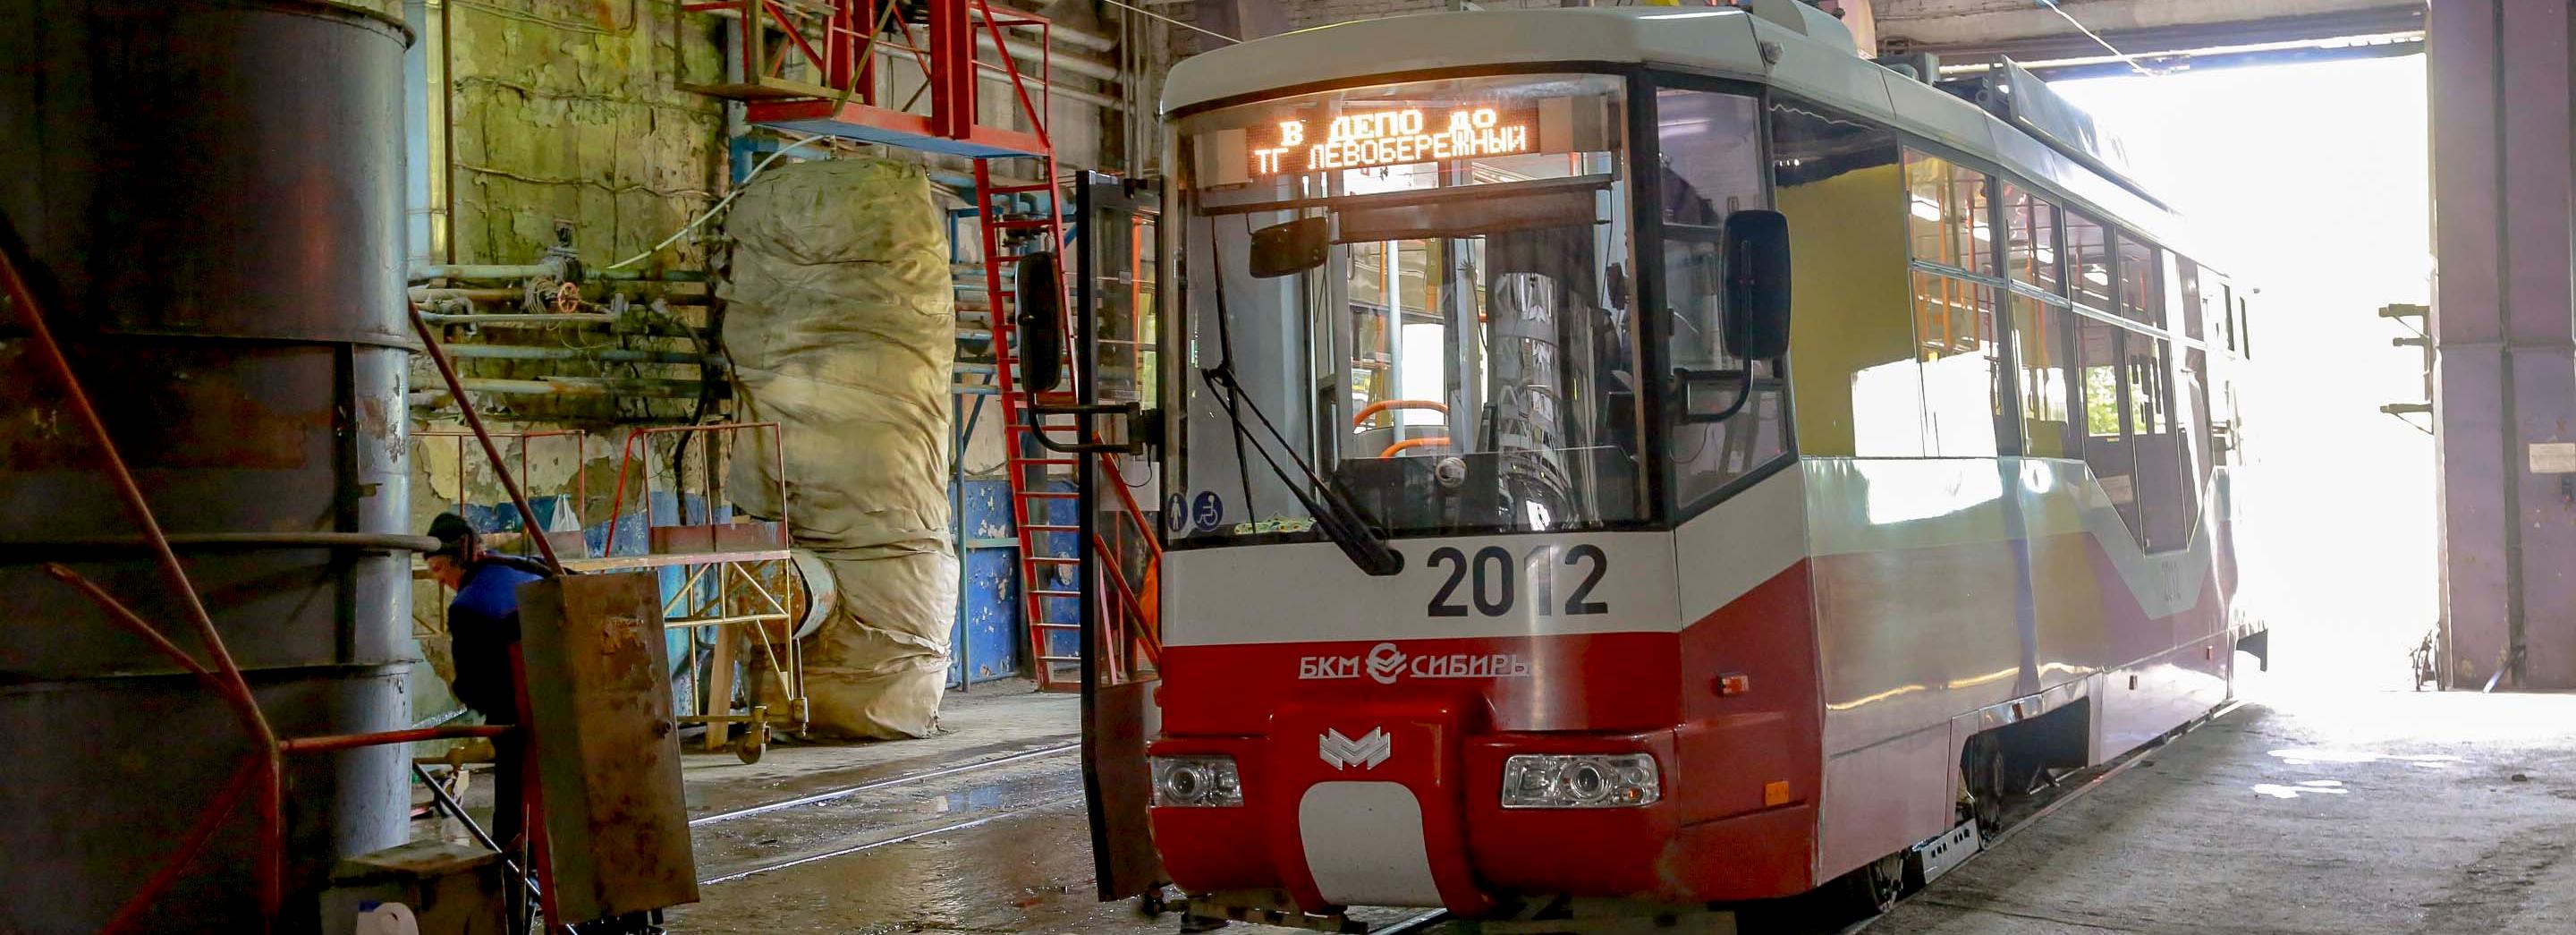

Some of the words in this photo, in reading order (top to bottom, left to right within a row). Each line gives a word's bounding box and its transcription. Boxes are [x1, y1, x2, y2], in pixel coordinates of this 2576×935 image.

[1280, 120, 1303, 146] В
[1327, 109, 1423, 142] ДЕПО
[1254, 148, 1288, 174] ТГ
[1308, 125, 1526, 169] ЛЕВОБЕРЕЖНЫЙ
[1427, 544, 1608, 617] 2012
[1299, 655, 1360, 678] БКМ
[1411, 654, 1530, 677] СИБИРЬ
